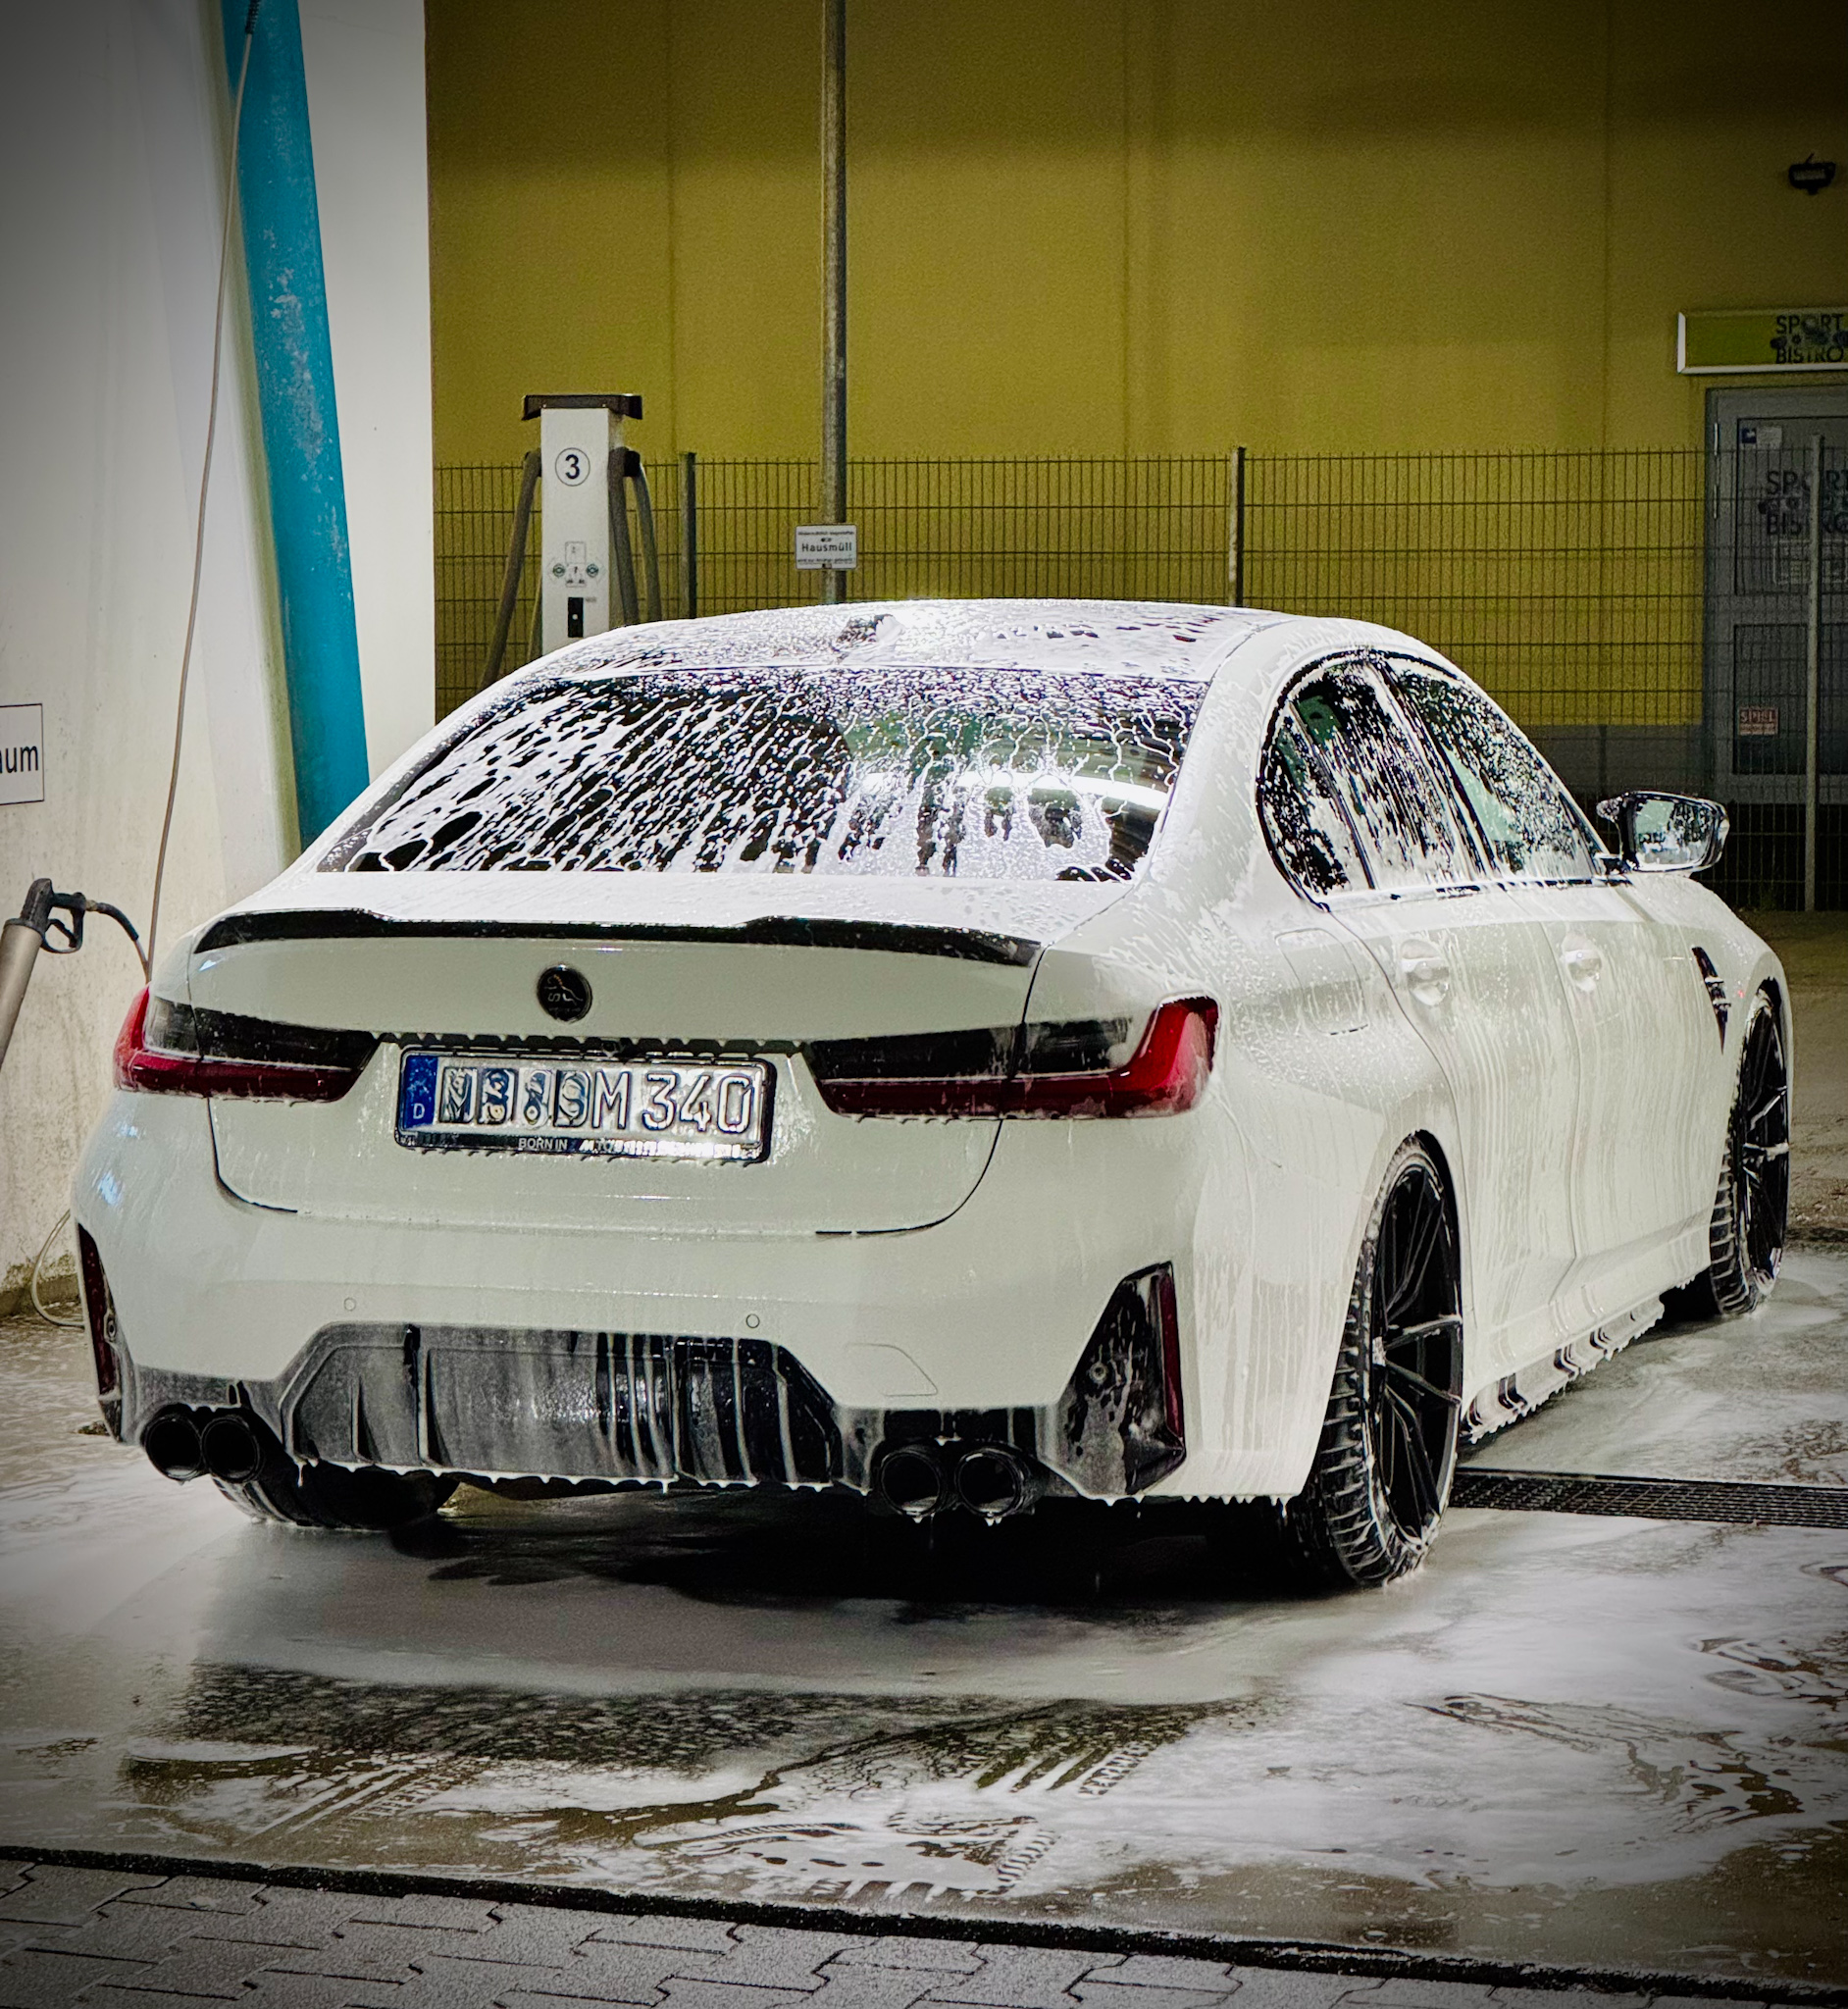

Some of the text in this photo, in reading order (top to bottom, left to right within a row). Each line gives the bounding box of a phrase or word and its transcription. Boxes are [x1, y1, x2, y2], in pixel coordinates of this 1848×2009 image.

[564, 453, 581, 480] 3
[801, 541, 852, 552] Hausmüll
[0, 746, 38, 774] um
[412, 1104, 425, 1120] D
[642, 1072, 751, 1134] 340
[518, 1138, 548, 1151] BORN
[550, 1138, 568, 1151] IN
